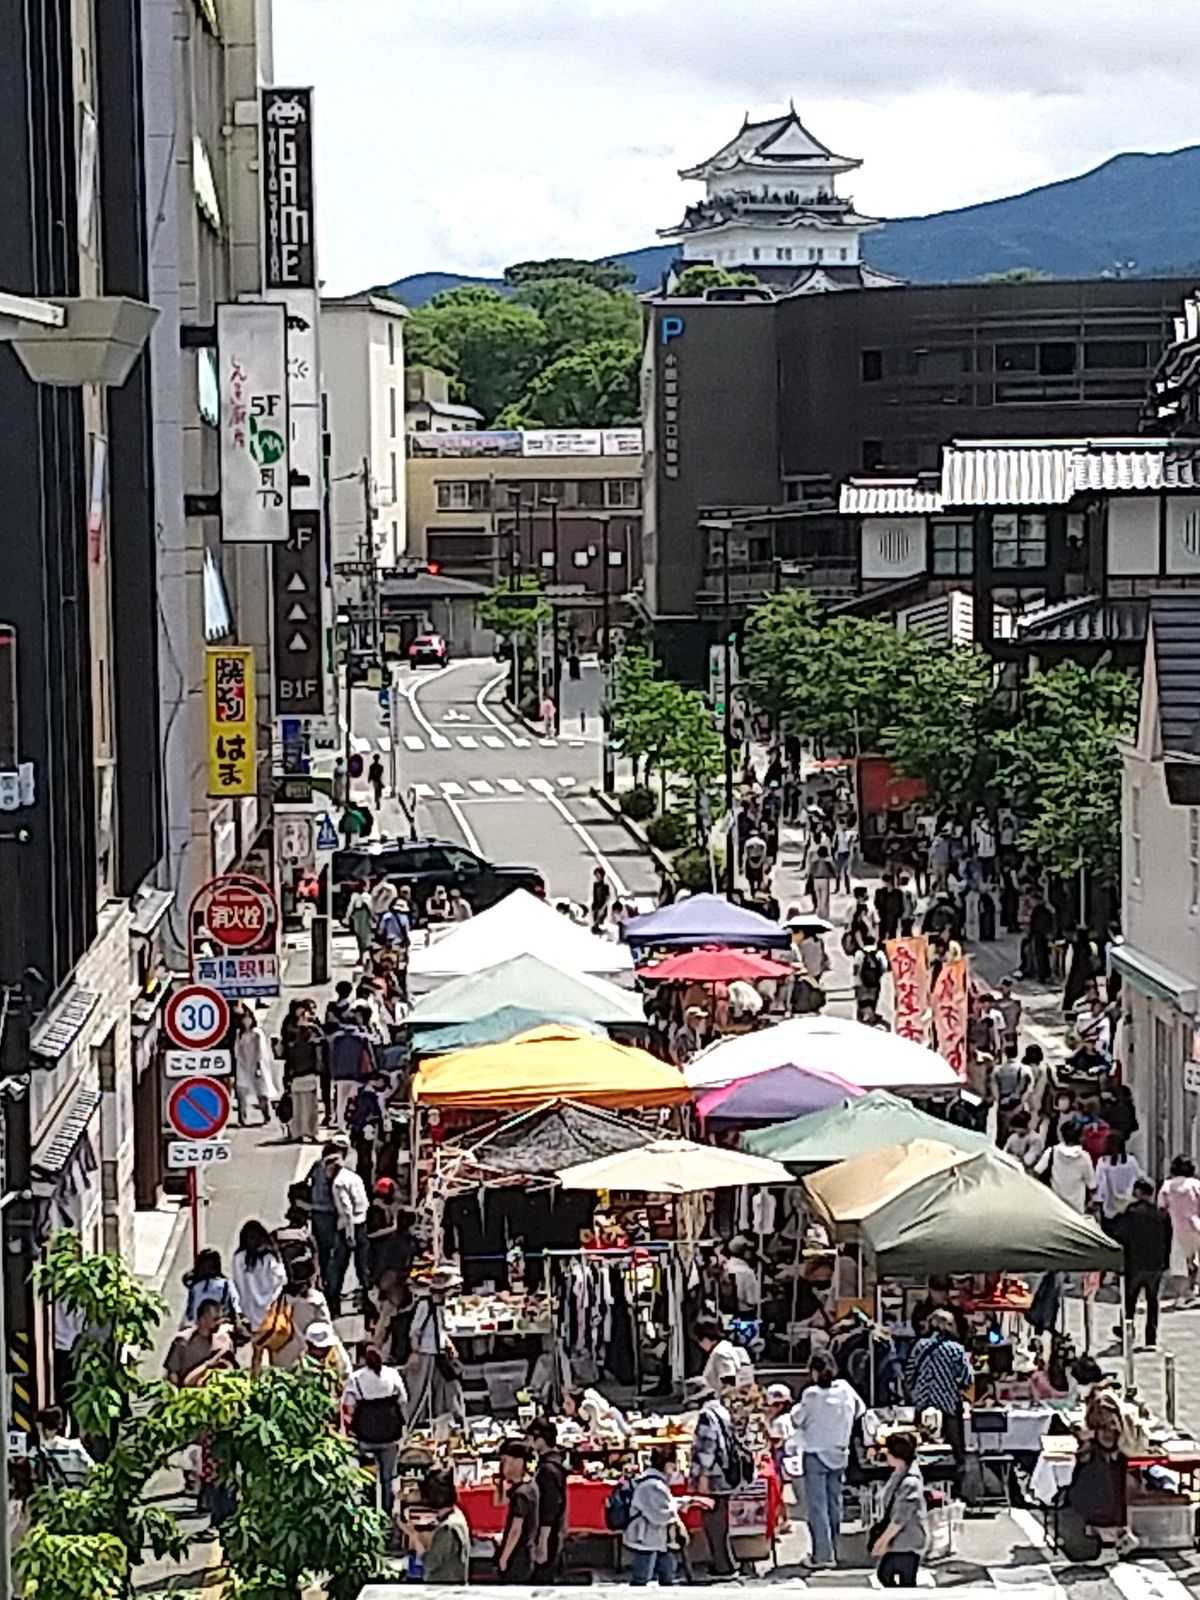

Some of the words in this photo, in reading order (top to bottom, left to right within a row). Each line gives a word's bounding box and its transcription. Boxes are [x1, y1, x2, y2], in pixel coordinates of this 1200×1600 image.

[279, 127, 309, 282] GAME
[661, 317, 684, 345] P
[251, 395, 281, 417] 5F
[280, 680, 318, 699] B1F
[217, 735, 245, 786] はま
[211, 905, 261, 929] 消火栓
[181, 1004, 216, 1032] 30
[171, 1056, 226, 1070] ここから
[173, 1146, 228, 1161] ここから
